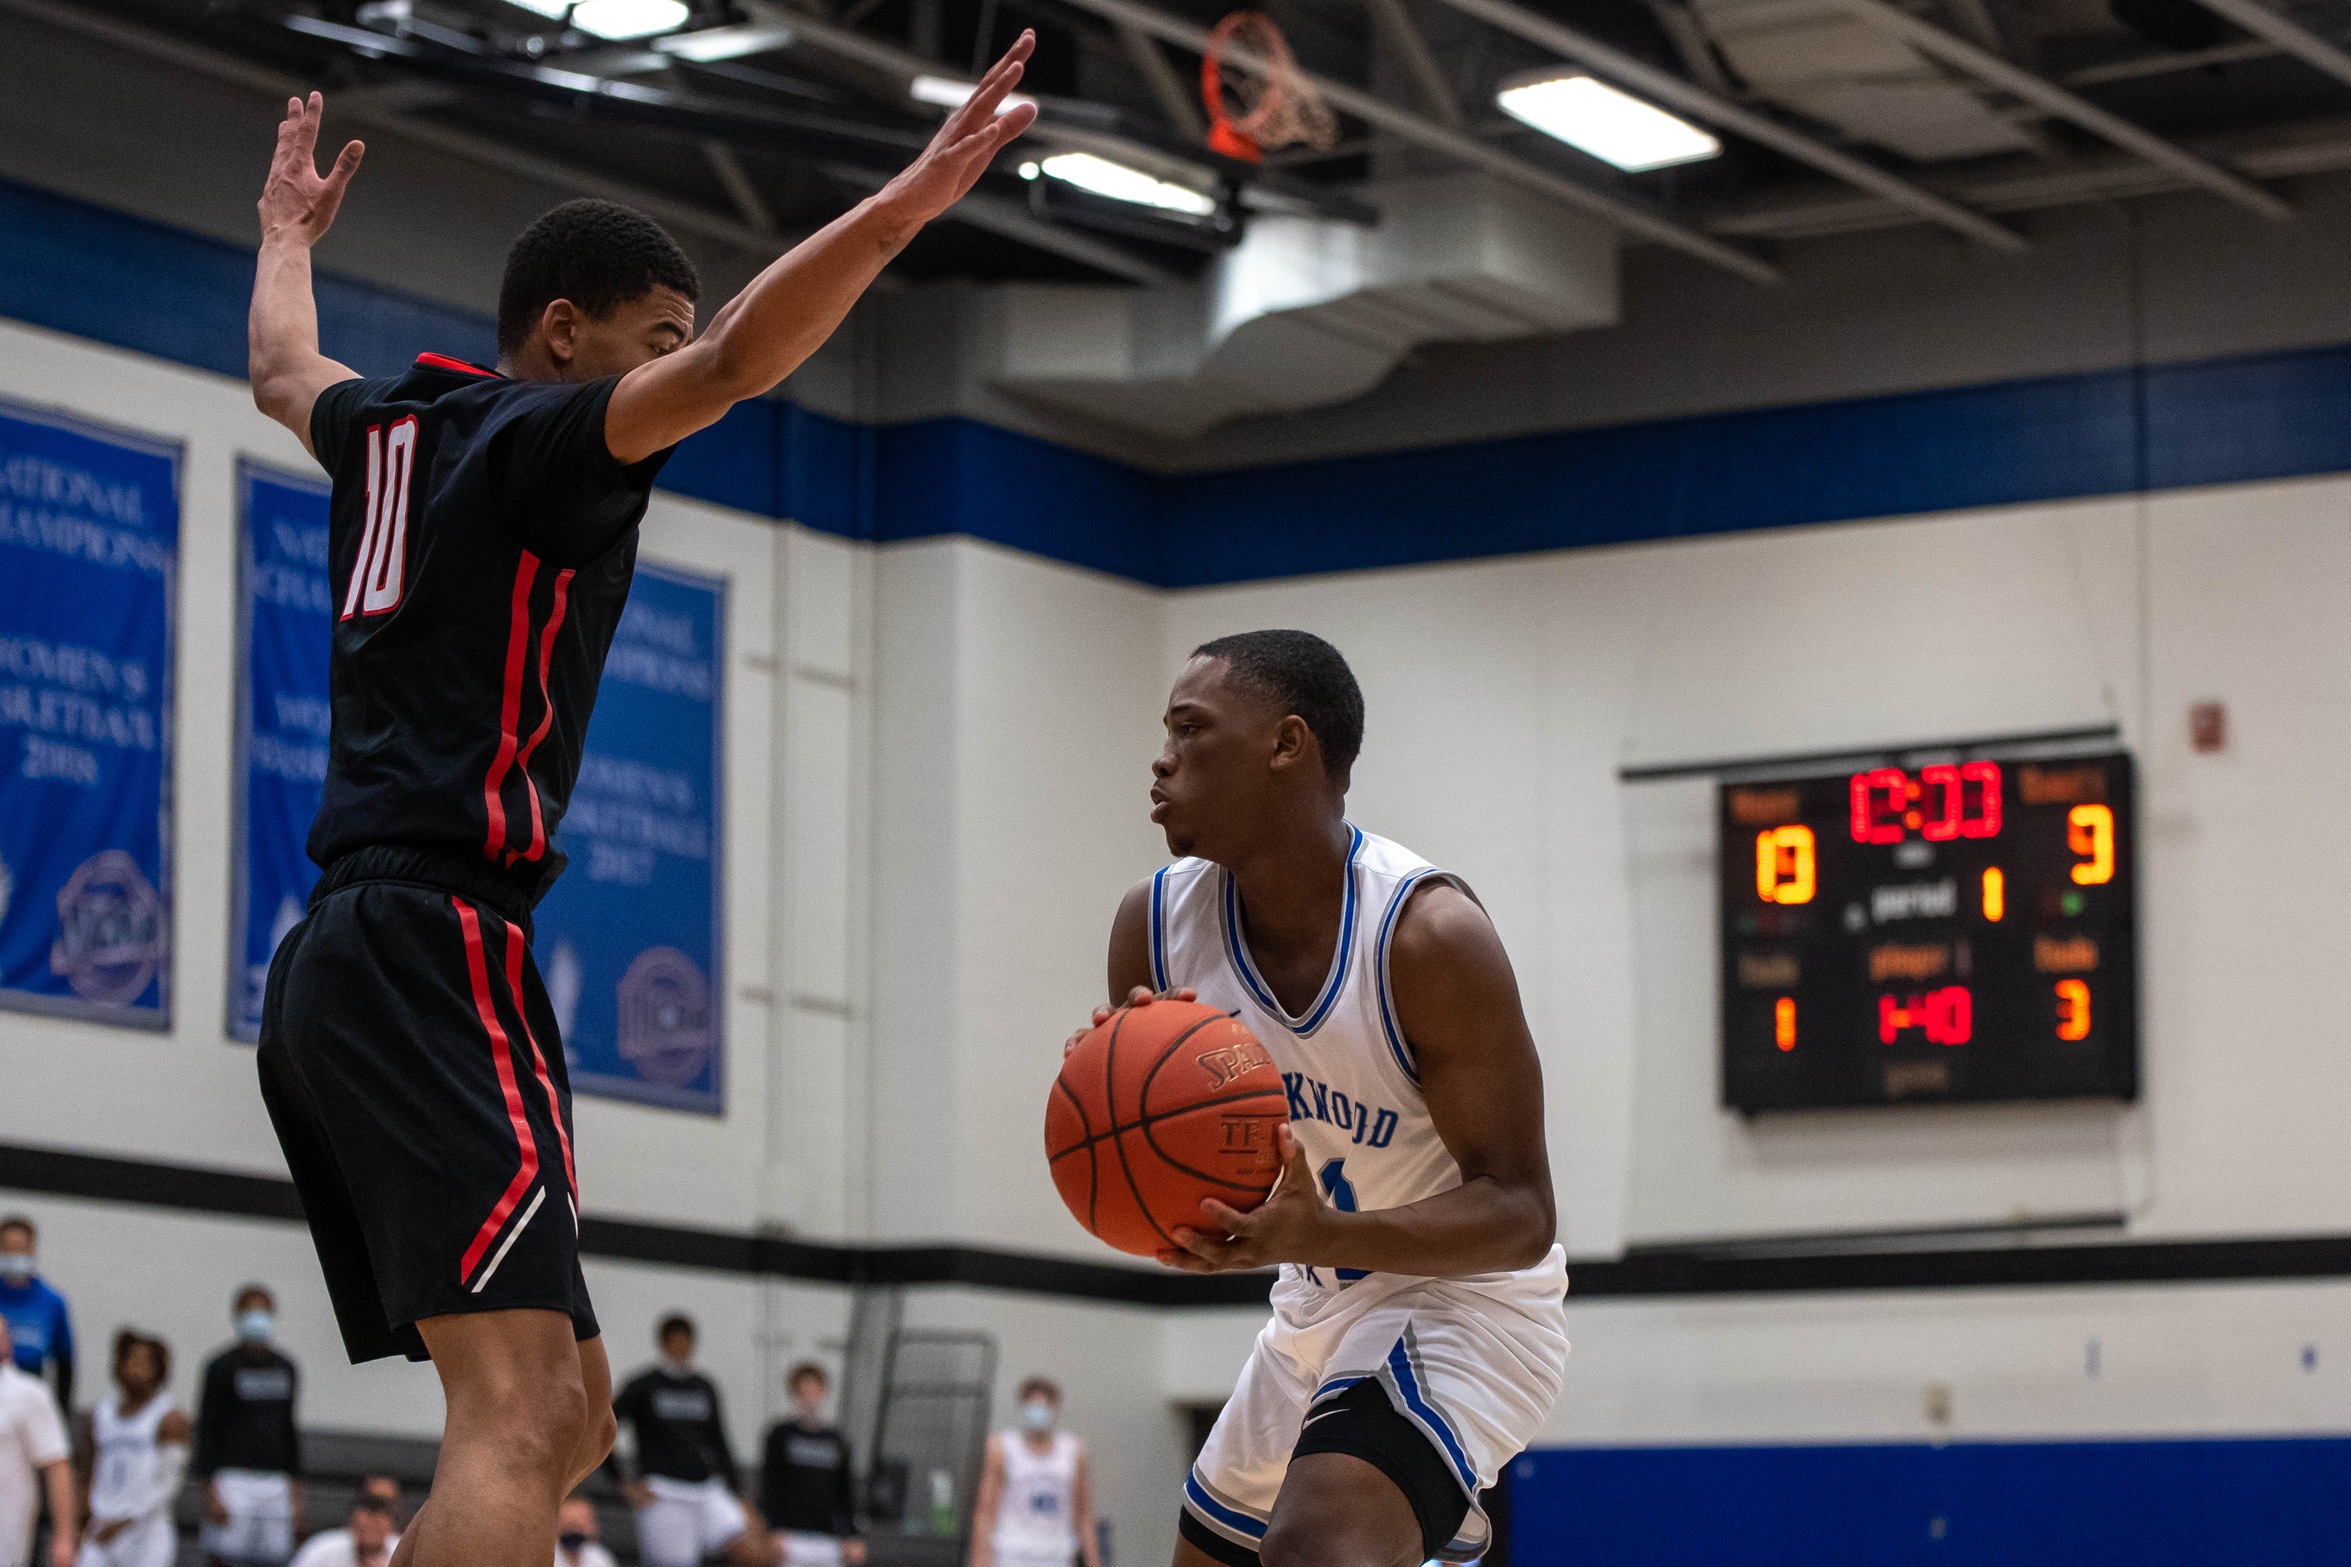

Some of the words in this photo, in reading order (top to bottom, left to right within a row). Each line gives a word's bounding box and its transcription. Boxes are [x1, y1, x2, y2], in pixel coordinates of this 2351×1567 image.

[340, 413, 418, 622] 10
[1982, 866, 2004, 922] 1
[1775, 996, 1797, 1051] 1
[2055, 979, 2091, 1041] 3
